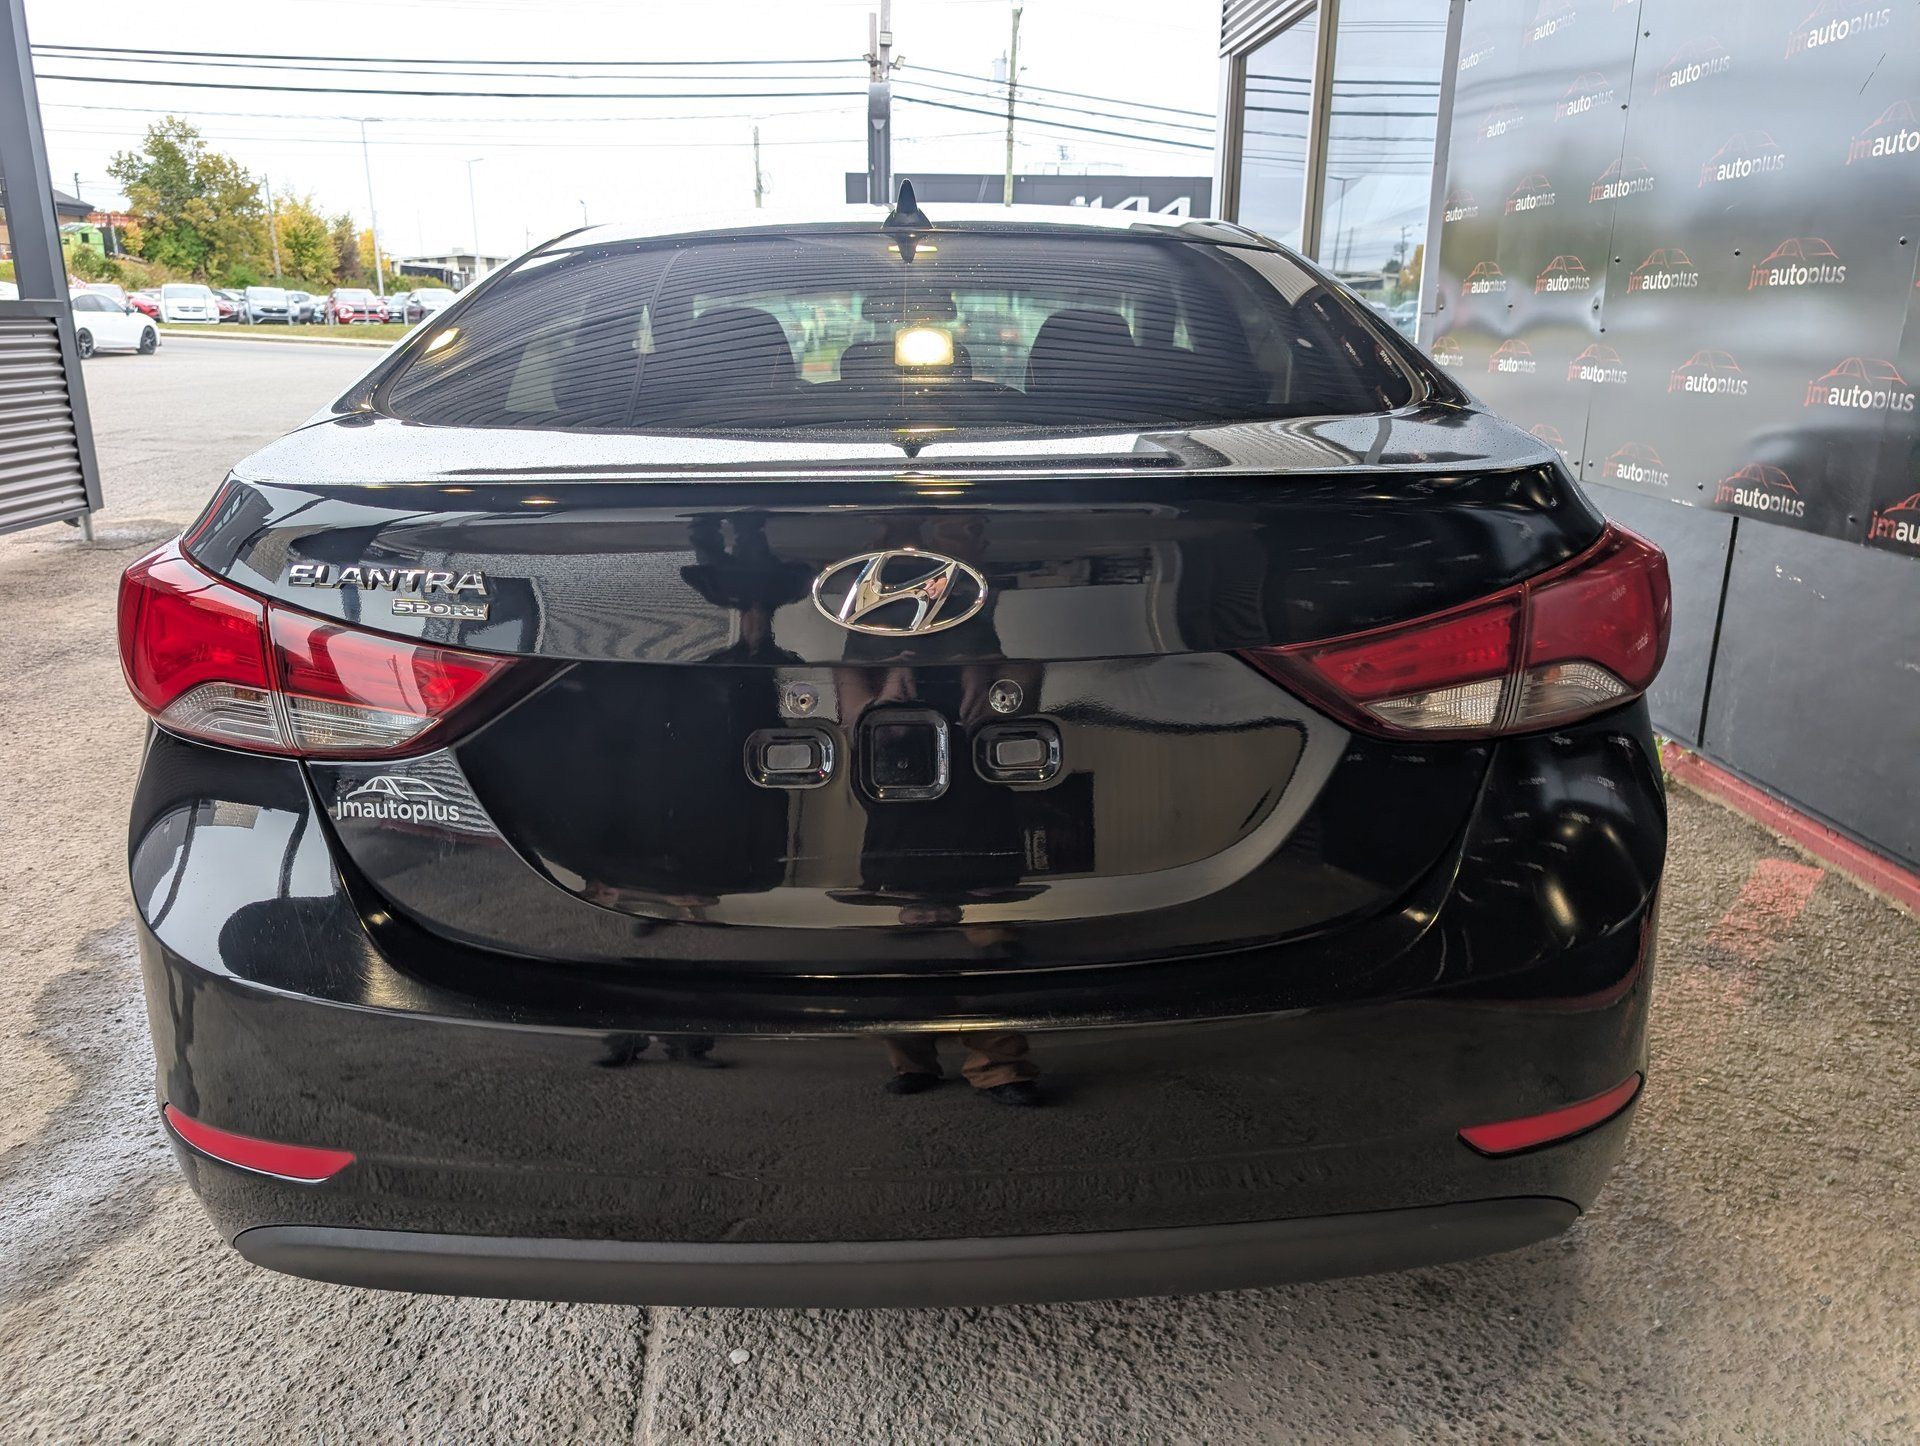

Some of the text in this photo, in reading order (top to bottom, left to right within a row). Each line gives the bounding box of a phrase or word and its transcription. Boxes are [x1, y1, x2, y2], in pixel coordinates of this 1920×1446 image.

[1534, 274, 1590, 295] jmautoplus
[1626, 270, 1699, 295] jmautoplus
[1747, 263, 1847, 291] jmautoplus
[1667, 370, 1748, 395] jmautoplus
[1804, 380, 1915, 412] jmautoplus
[1715, 480, 1805, 518] jmautoplus
[289, 563, 488, 596] ELANTRA
[393, 600, 488, 617] SPORT
[336, 797, 460, 823] jmautoplus
